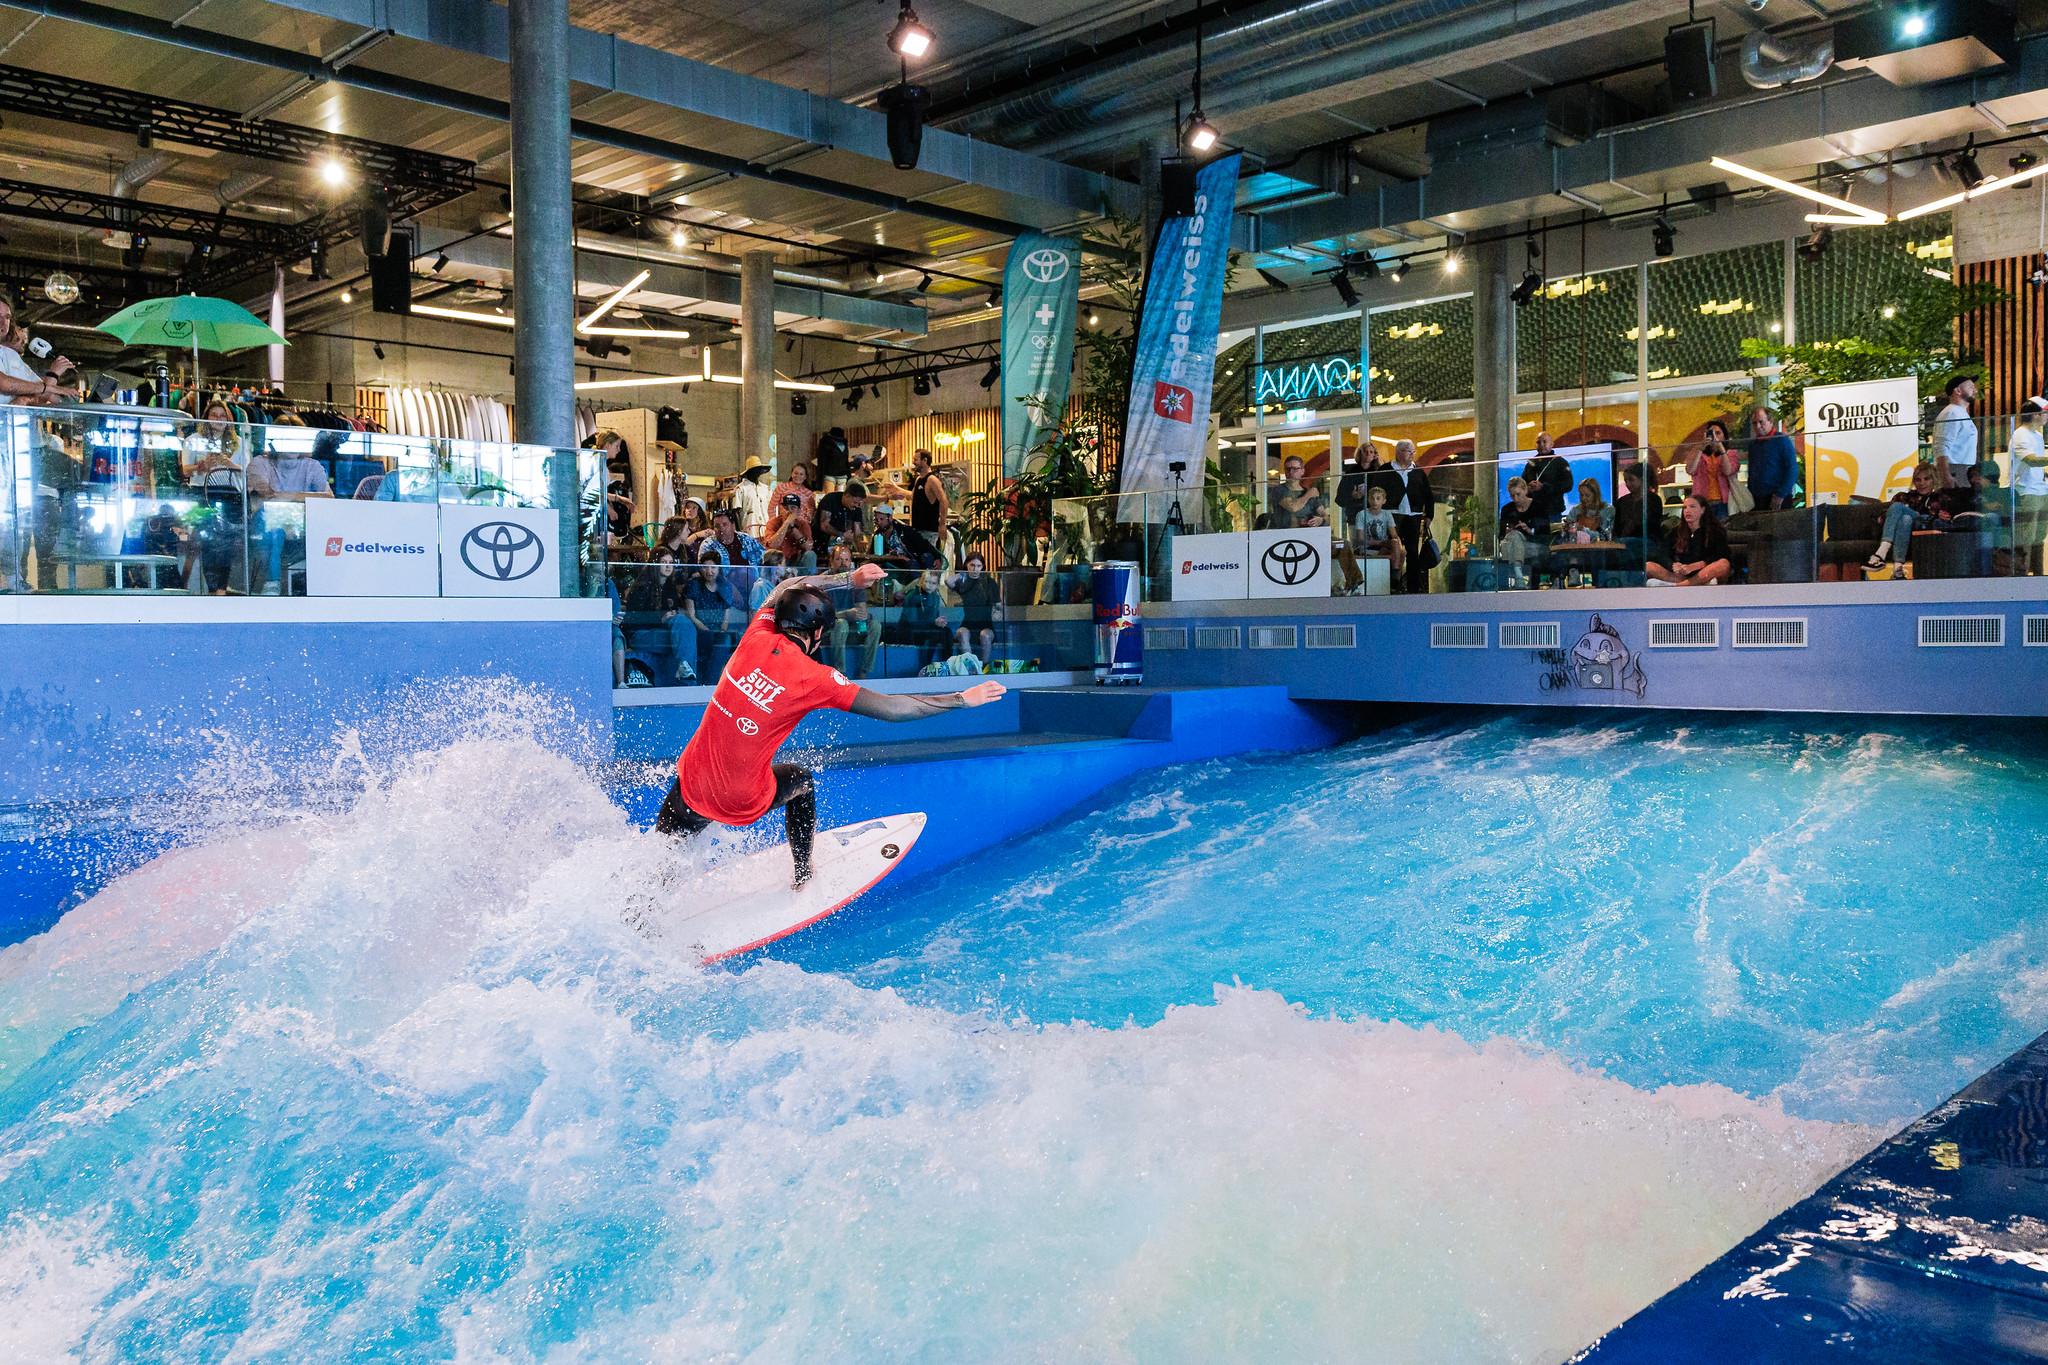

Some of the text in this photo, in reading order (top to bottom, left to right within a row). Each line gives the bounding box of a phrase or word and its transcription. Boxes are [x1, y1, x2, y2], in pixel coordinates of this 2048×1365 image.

[1170, 194, 1207, 380] edelweiss
[1818, 402, 1900, 428] PHILOSO
[344, 542, 425, 554] edelweiss
[1192, 561, 1240, 571] edelweiss
[1096, 603, 1121, 617] Red
[747, 673, 786, 698] surf
